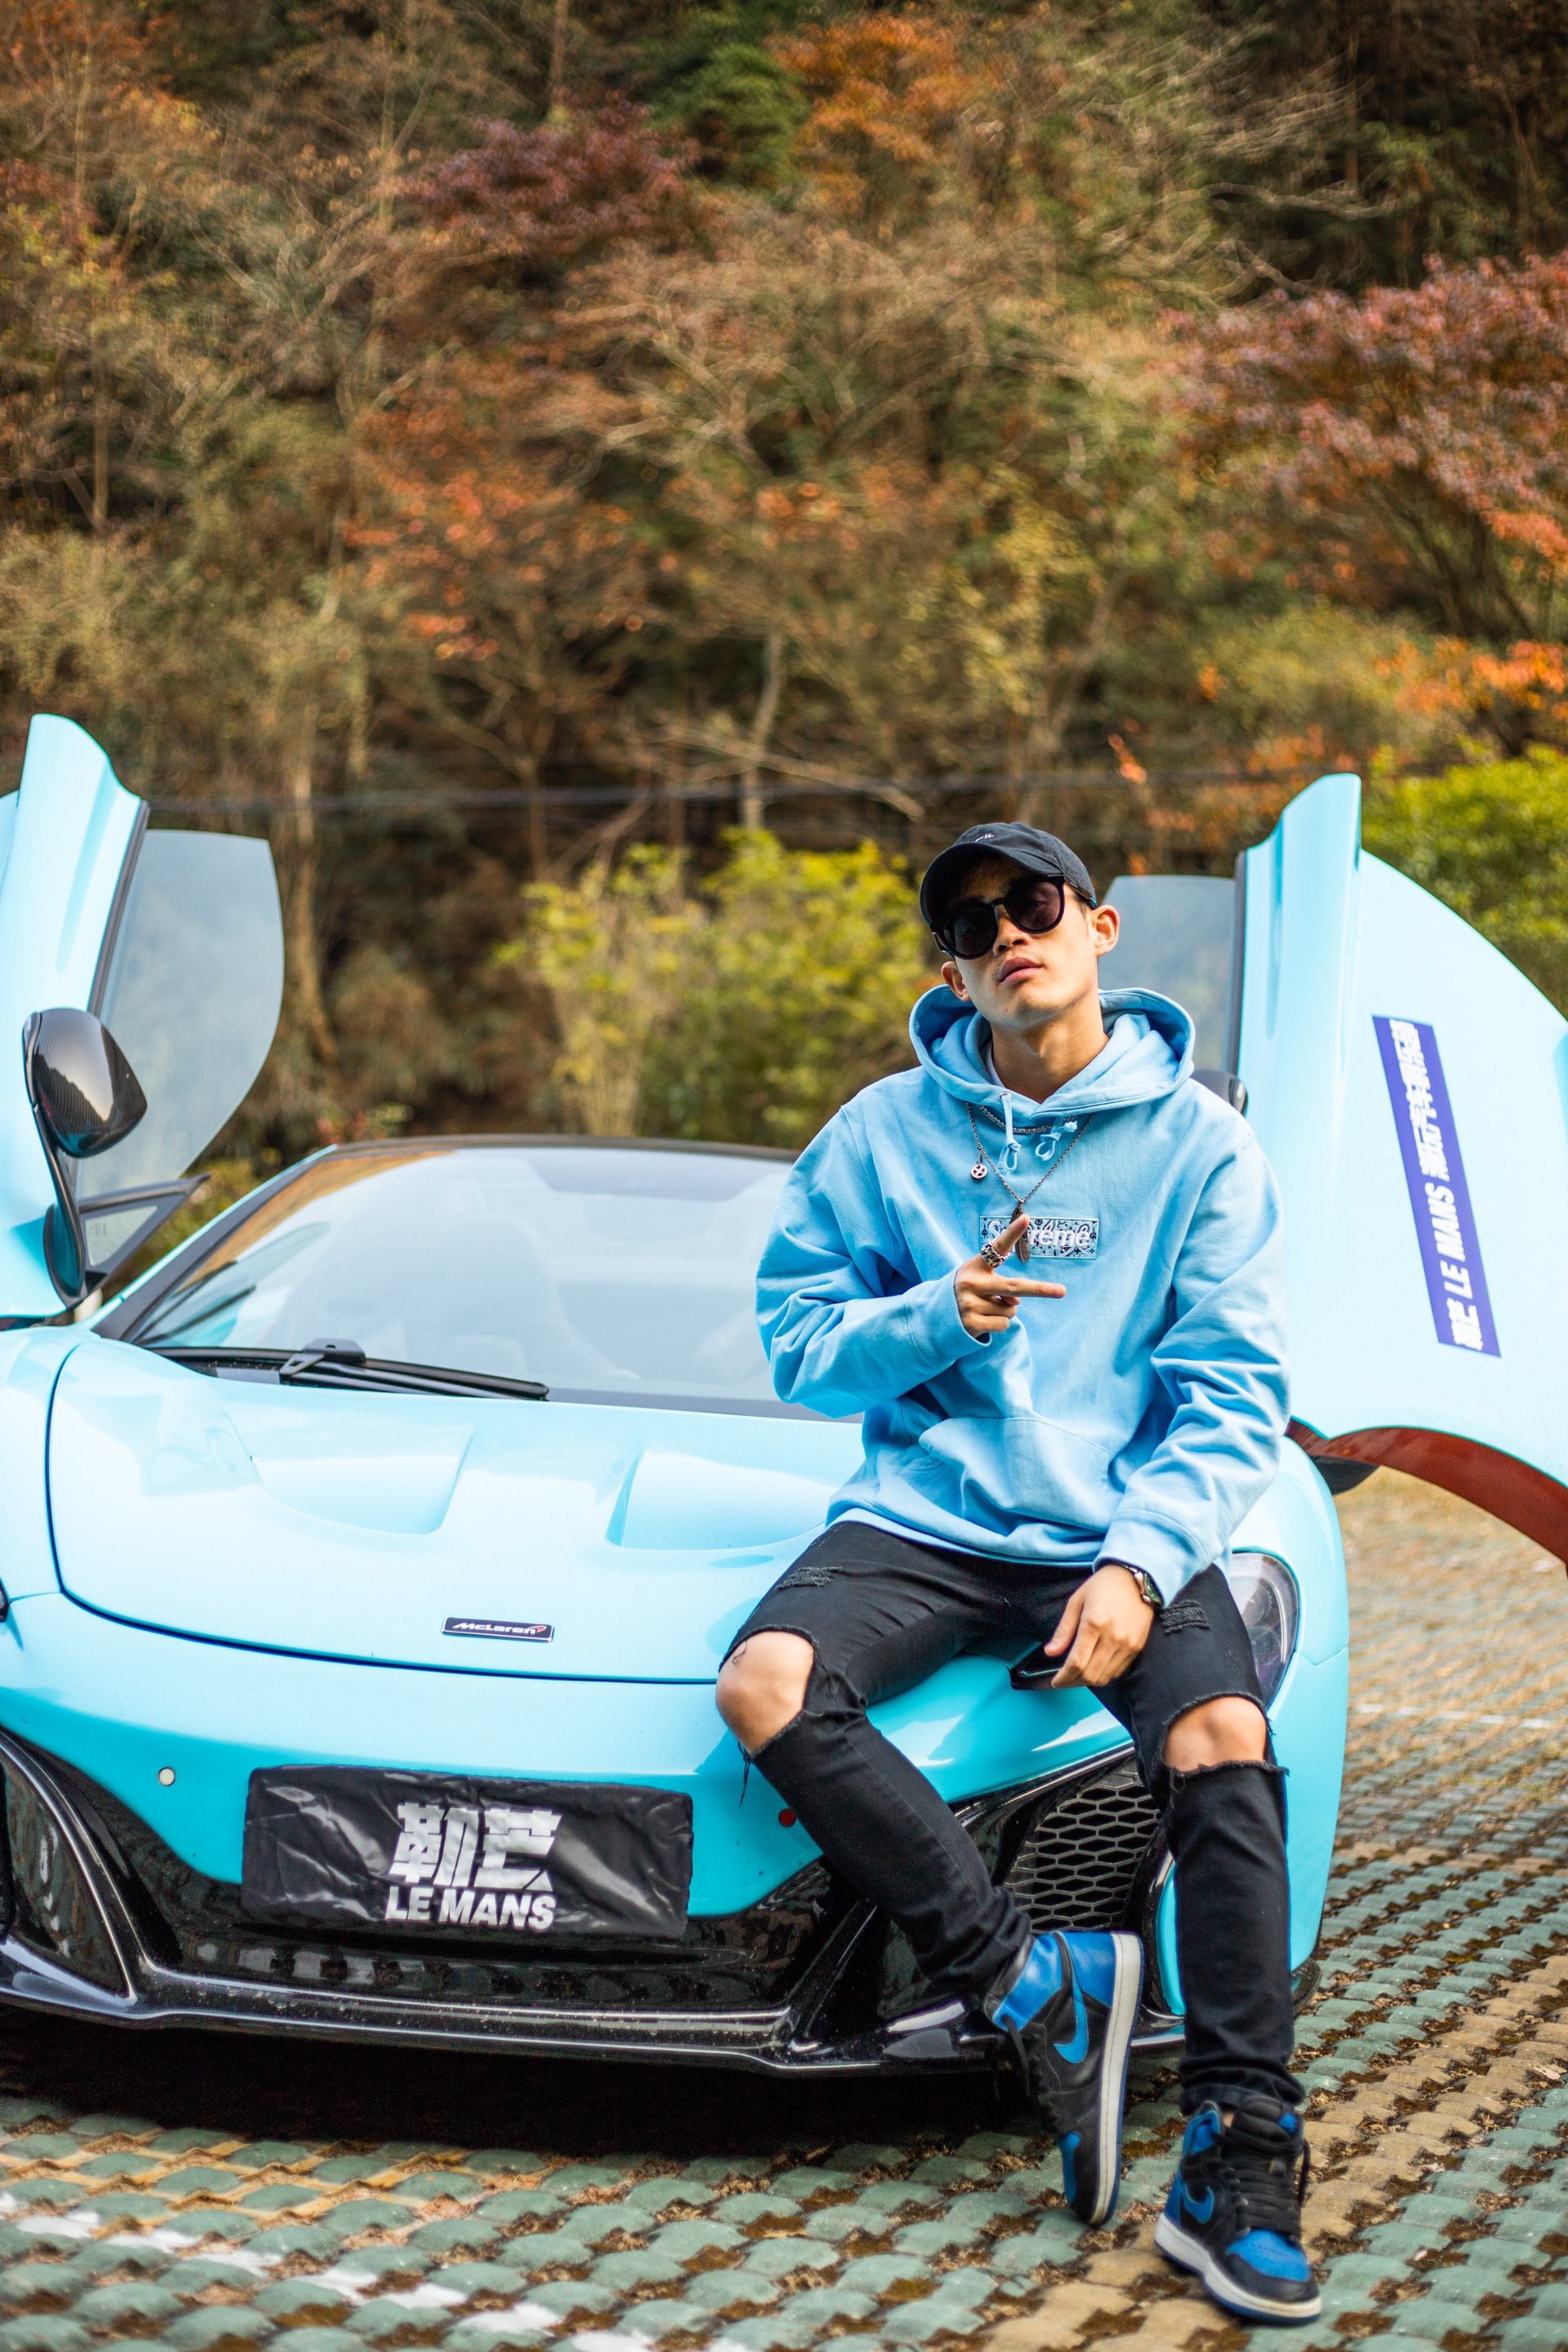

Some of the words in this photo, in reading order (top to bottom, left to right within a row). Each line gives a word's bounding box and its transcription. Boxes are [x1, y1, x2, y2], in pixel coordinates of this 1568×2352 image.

[985, 1220, 1092, 1250] Sreme
[1424, 1182, 1466, 1263] MANS
[1440, 1260, 1473, 1299] LE
[452, 1622, 537, 1634] McLaren
[385, 1886, 431, 1922] LE
[441, 1888, 558, 1931] MANS
